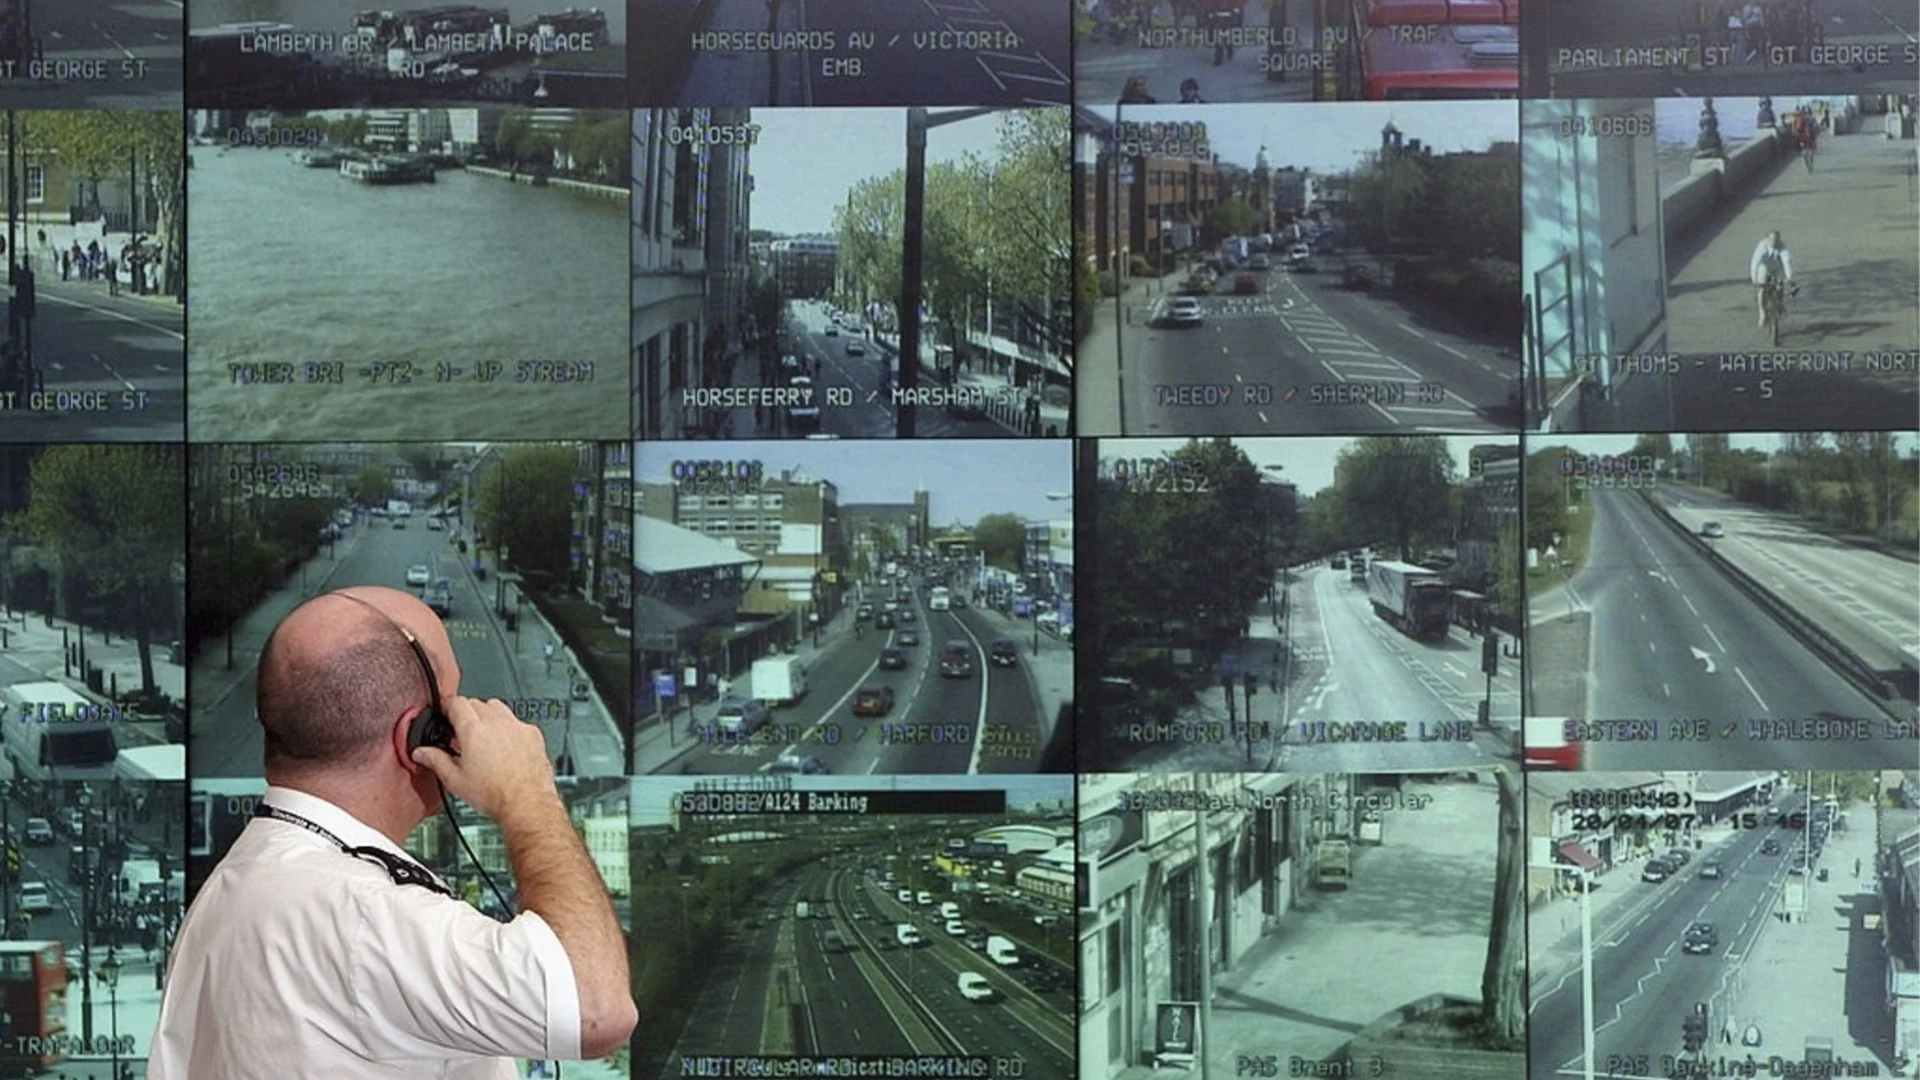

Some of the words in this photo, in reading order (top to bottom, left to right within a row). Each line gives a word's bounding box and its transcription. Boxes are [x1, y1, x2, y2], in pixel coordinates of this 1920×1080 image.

[240, 33, 333, 52] LAMBETH
[343, 34, 372, 51] BR
[411, 33, 503, 52] LAMBETH
[516, 32, 594, 52] PALACE
[692, 31, 835, 50] HORSEGUARDS
[849, 31, 874, 49] AV
[889, 34, 900, 47] /
[914, 31, 1019, 49] VICTORIA
[1139, 27, 1295, 47] NORTHUMBERLD
[1323, 25, 1348, 43] AV
[1389, 25, 1438, 42] TRAF
[1258, 51, 1336, 72] SQUARE
[1559, 48, 1689, 67] PARLIAMENT
[1704, 47, 1731, 65] ST
[1770, 46, 1796, 65] GT
[1811, 45, 1889, 64] GEORGE
[29, 60, 107, 79] GEORGE
[121, 60, 148, 79] ST
[400, 61, 425, 78] RD
[670, 124, 761, 144] 0410537
[228, 362, 294, 383] TOWER
[303, 362, 345, 383] BRI
[474, 361, 503, 382] UP
[514, 360, 594, 382] STREAM
[1615, 354, 1680, 373] THOMS
[1720, 352, 1851, 372] WATERFRONT
[683, 388, 813, 406] HORSEFERRY
[826, 387, 851, 406] RD
[866, 389, 878, 403] /
[892, 387, 983, 406] MARSHAM
[1154, 386, 1231, 406] TWEEDY
[1244, 386, 1271, 404] RD
[1284, 387, 1298, 401] /
[1310, 384, 1404, 405] SHERMAN
[1417, 382, 1444, 402] RD
[1759, 379, 1773, 398] S
[30, 391, 108, 411] GEORGE
[122, 391, 148, 410] ST
[814, 724, 842, 744] RD
[881, 724, 970, 744] HARFORD
[1128, 723, 1225, 742] ROMFORD
[1300, 720, 1408, 742] VICARAGE
[1418, 720, 1474, 742] LANE
[1562, 720, 1658, 742] EASTERN
[1668, 720, 1711, 740] AVE
[1749, 719, 1872, 741] WHALEBONE
[808, 793, 868, 812] Barking
[1250, 791, 1314, 811] North
[1329, 791, 1432, 811] Circular
[1571, 813, 1695, 831] 20/04/07
[1287, 1054, 1355, 1078] Brent
[1369, 1055, 1385, 1077] 3
